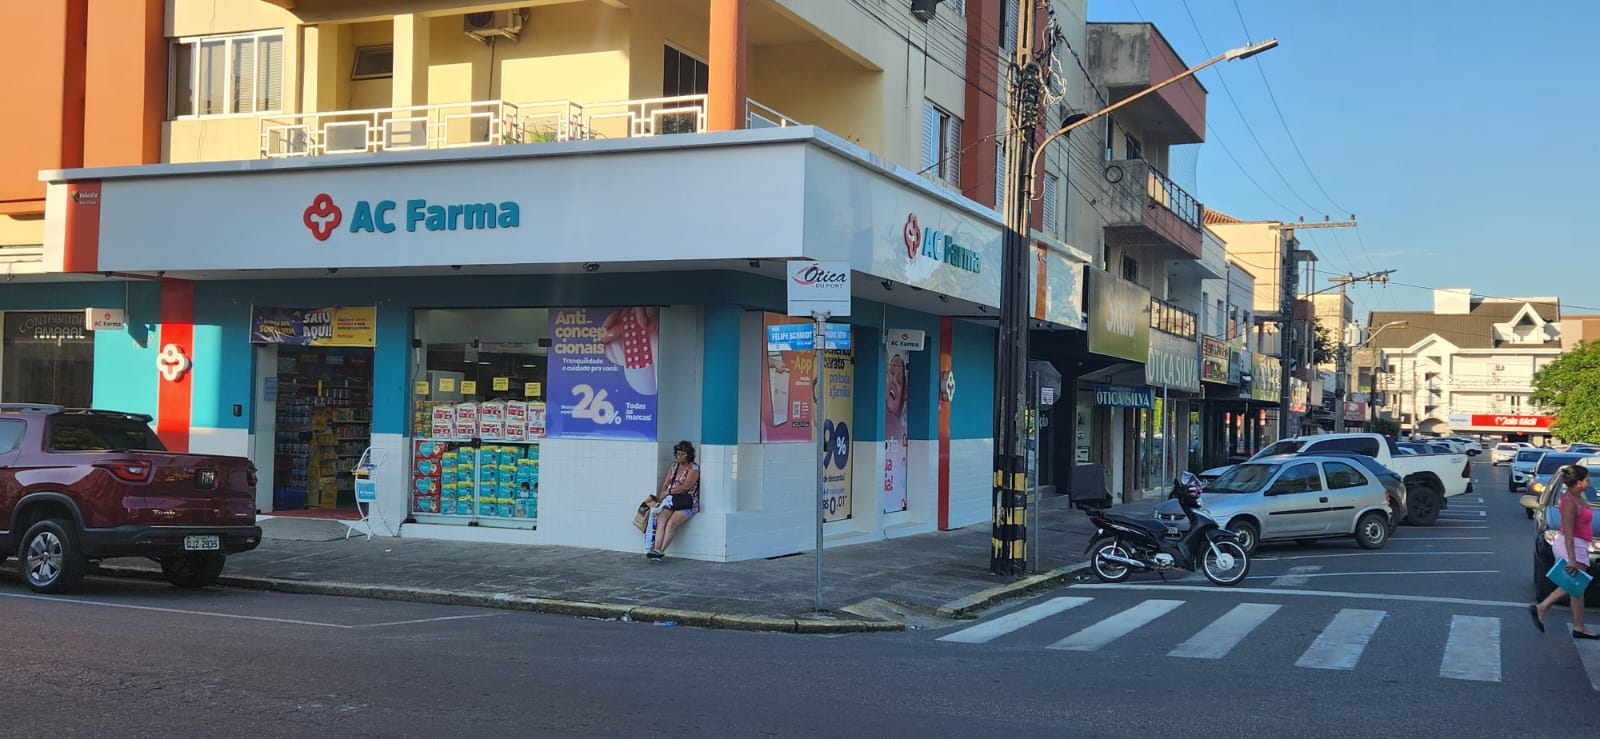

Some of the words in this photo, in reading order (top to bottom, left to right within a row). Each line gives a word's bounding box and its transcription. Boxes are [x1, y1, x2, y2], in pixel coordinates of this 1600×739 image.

[349, 200, 396, 233] AC
[406, 198, 520, 232] Farma
[922, 227, 943, 261] AC
[944, 234, 980, 273] Farma
[805, 263, 847, 283] Ótica
[303, 313, 331, 323] SAIU
[555, 338, 605, 354] cionais
[625, 402, 646, 410] Todas
